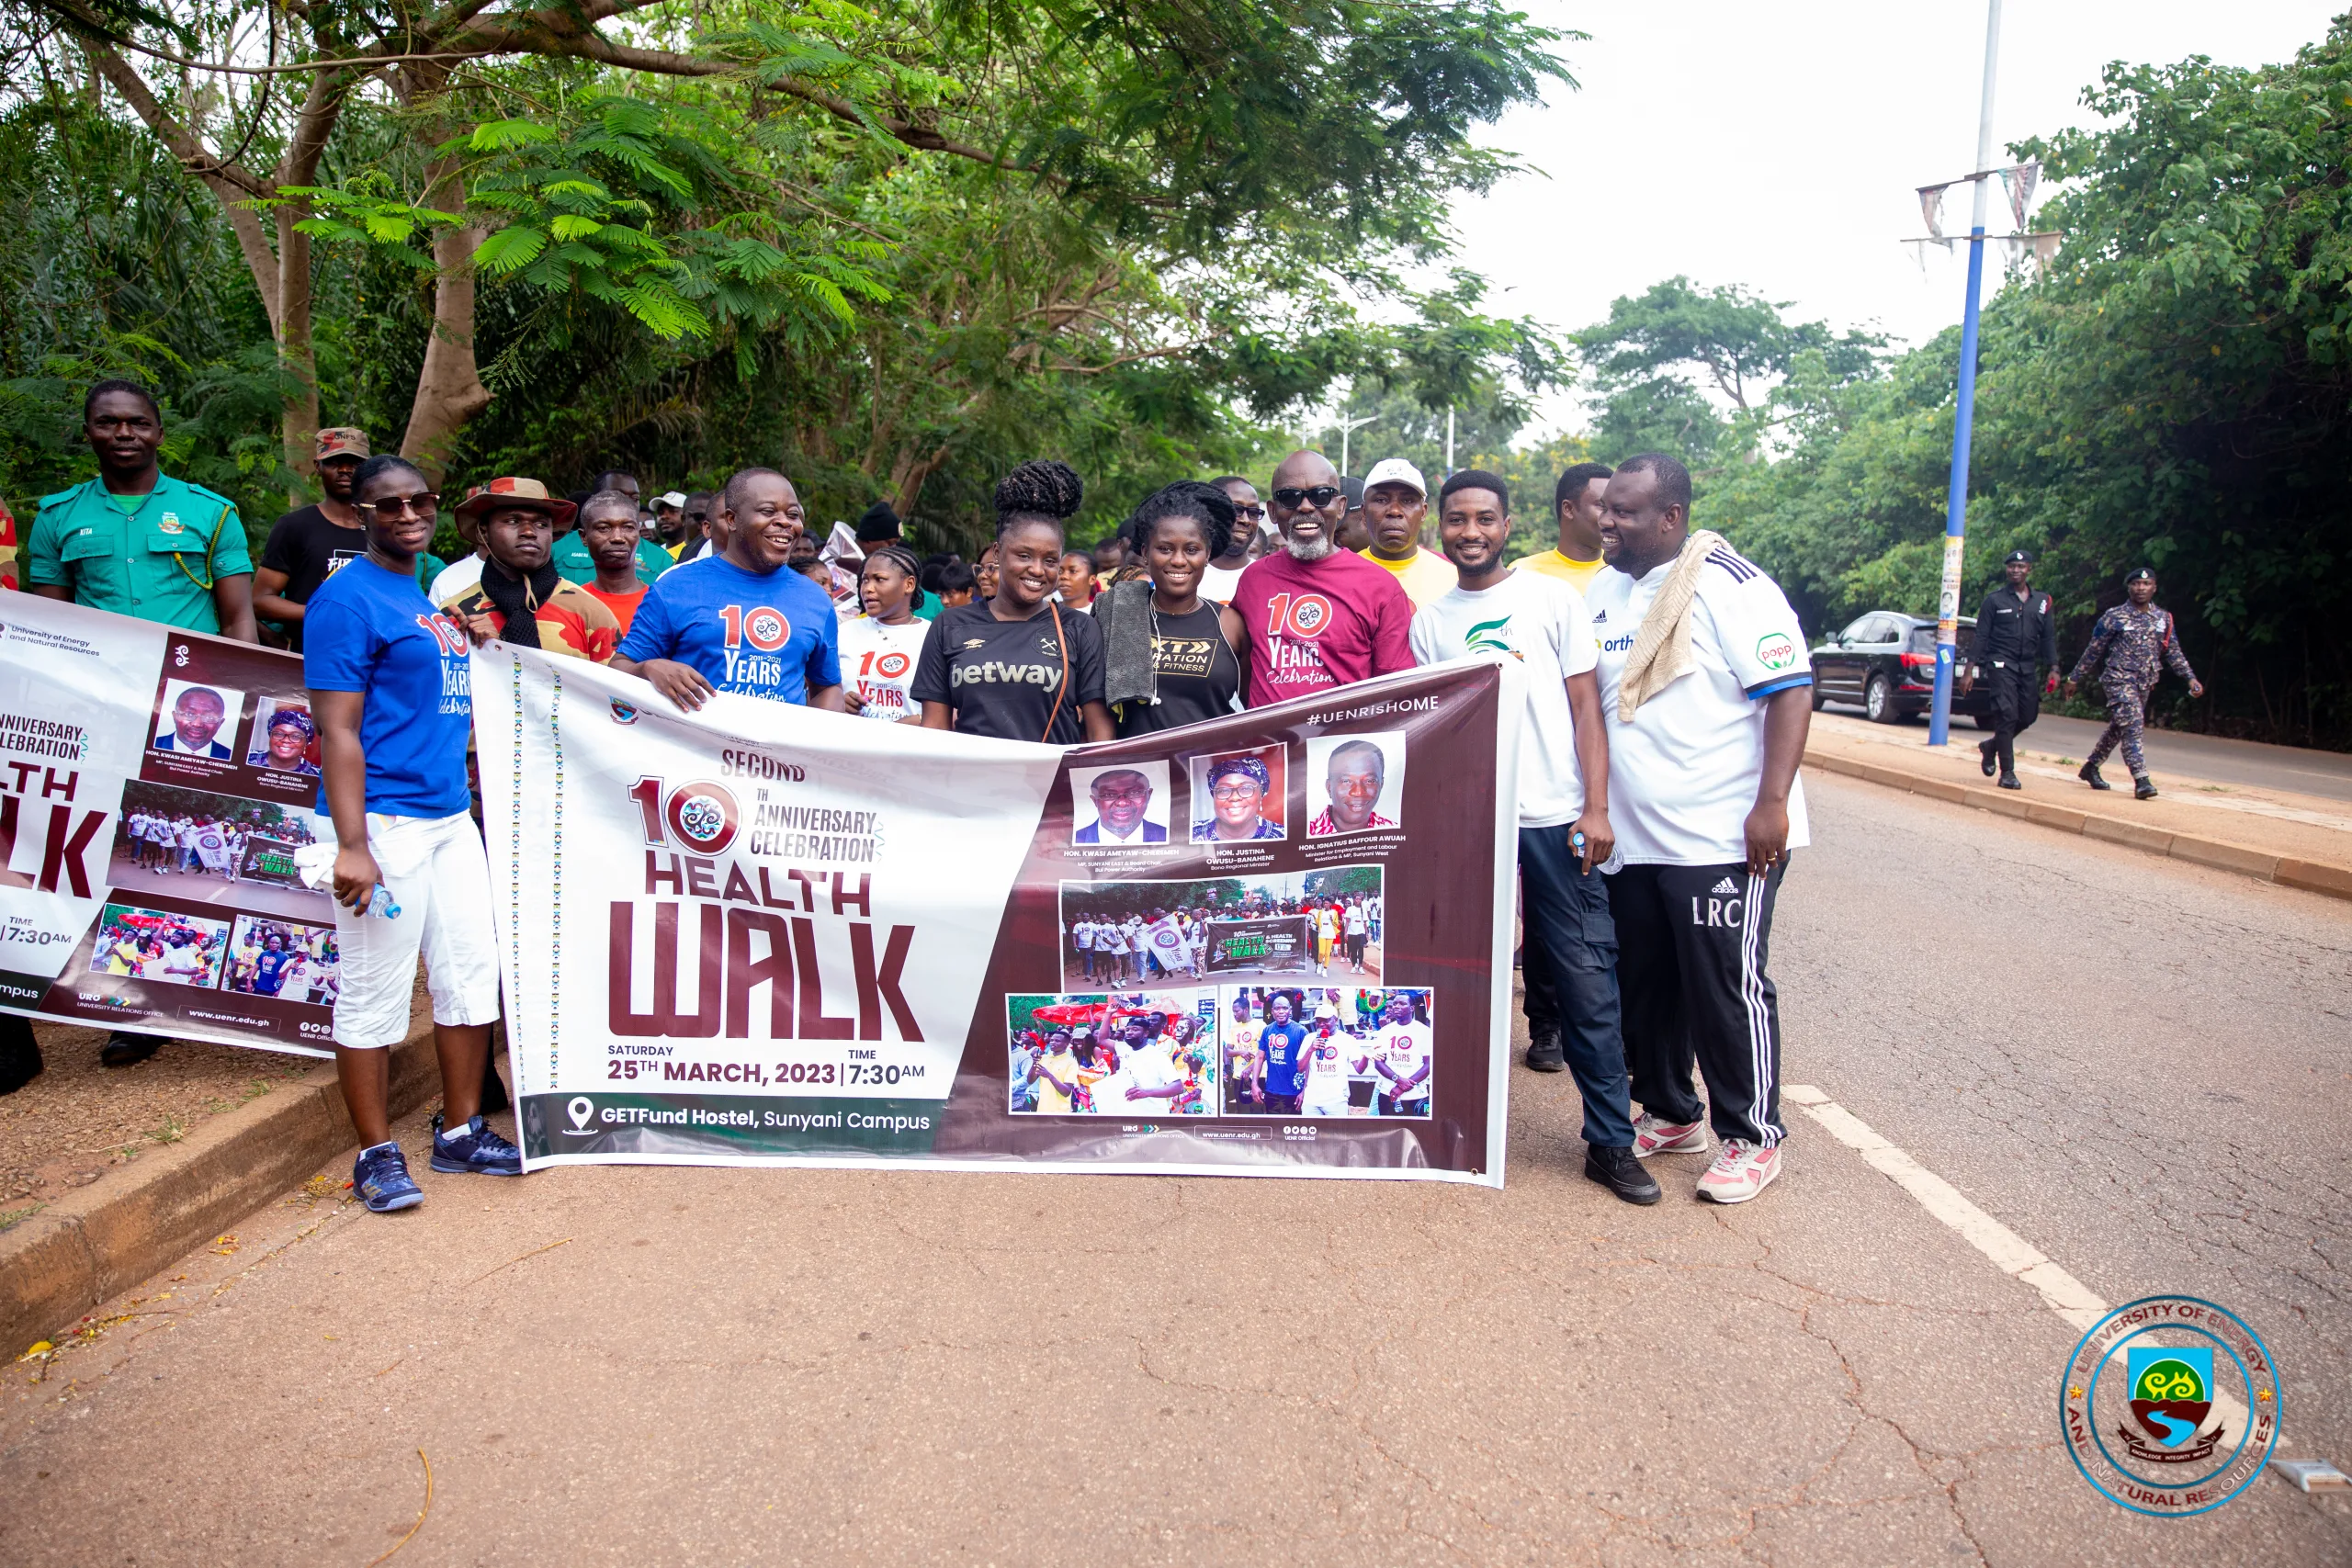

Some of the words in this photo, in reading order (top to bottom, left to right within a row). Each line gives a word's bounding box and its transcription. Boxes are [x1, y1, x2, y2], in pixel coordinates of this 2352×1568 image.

[1267, 592, 1333, 638] 10
[718, 604, 791, 652] 10
[9, 634, 26, 642] and
[28, 637, 58, 649] Natural
[59, 643, 100, 657] Resources
[11, 626, 52, 639] University
[62, 636, 90, 648] Energy
[1604, 634, 1634, 651] orth
[749, 654, 782, 664] 2011-2021
[1761, 644, 1792, 662] popp
[723, 649, 782, 686] YEARS
[857, 650, 910, 679] 10
[1163, 662, 1205, 672] FITNESS
[951, 660, 1063, 693] betway
[1266, 668, 1335, 685] Celebration
[1306, 695, 1440, 726] #UENRisHOME
[145, 750, 160, 758] HON.
[161, 752, 180, 761] KWASI
[720, 749, 806, 783] SECOND
[279, 774, 302, 783] JUSTINA
[757, 787, 769, 802] TH
[627, 774, 742, 858] 10
[754, 804, 876, 835] ANNIVERSARY
[750, 829, 876, 863] CELEBRATION
[1235, 848, 1265, 856] JUSTINA
[1298, 843, 1316, 852] HON.
[1316, 840, 1348, 850] IGNATIUS
[1348, 836, 1378, 845] BAFFOUR
[1107, 849, 1180, 857] AMEYAW-CHEREMEH
[1206, 854, 1275, 864] OWUSU-BANAHENE
[1352, 850, 1374, 859] Sunyani
[1226, 863, 1249, 871] Regional
[645, 849, 872, 918] HEALTH
[1691, 897, 1742, 928] LRC
[9, 916, 34, 927] TIME
[1231, 944, 1266, 958] WALK
[608, 900, 925, 1043] WALK
[78, 992, 101, 1002] URO
[76, 1001, 110, 1010] UNIVERSITY
[111, 1006, 142, 1015] RELATIONS
[188, 1010, 270, 1027] www.uenr.edu.gh
[607, 1044, 673, 1056] SATURDAY
[848, 1049, 876, 1060] TIME
[663, 1061, 769, 1087] MARCH,
[775, 1062, 835, 1084] 2023
[601, 1105, 687, 1127] GETFund
[692, 1107, 760, 1129] Hostel,
[763, 1110, 842, 1132] Sunyani
[846, 1111, 931, 1134] Campus
